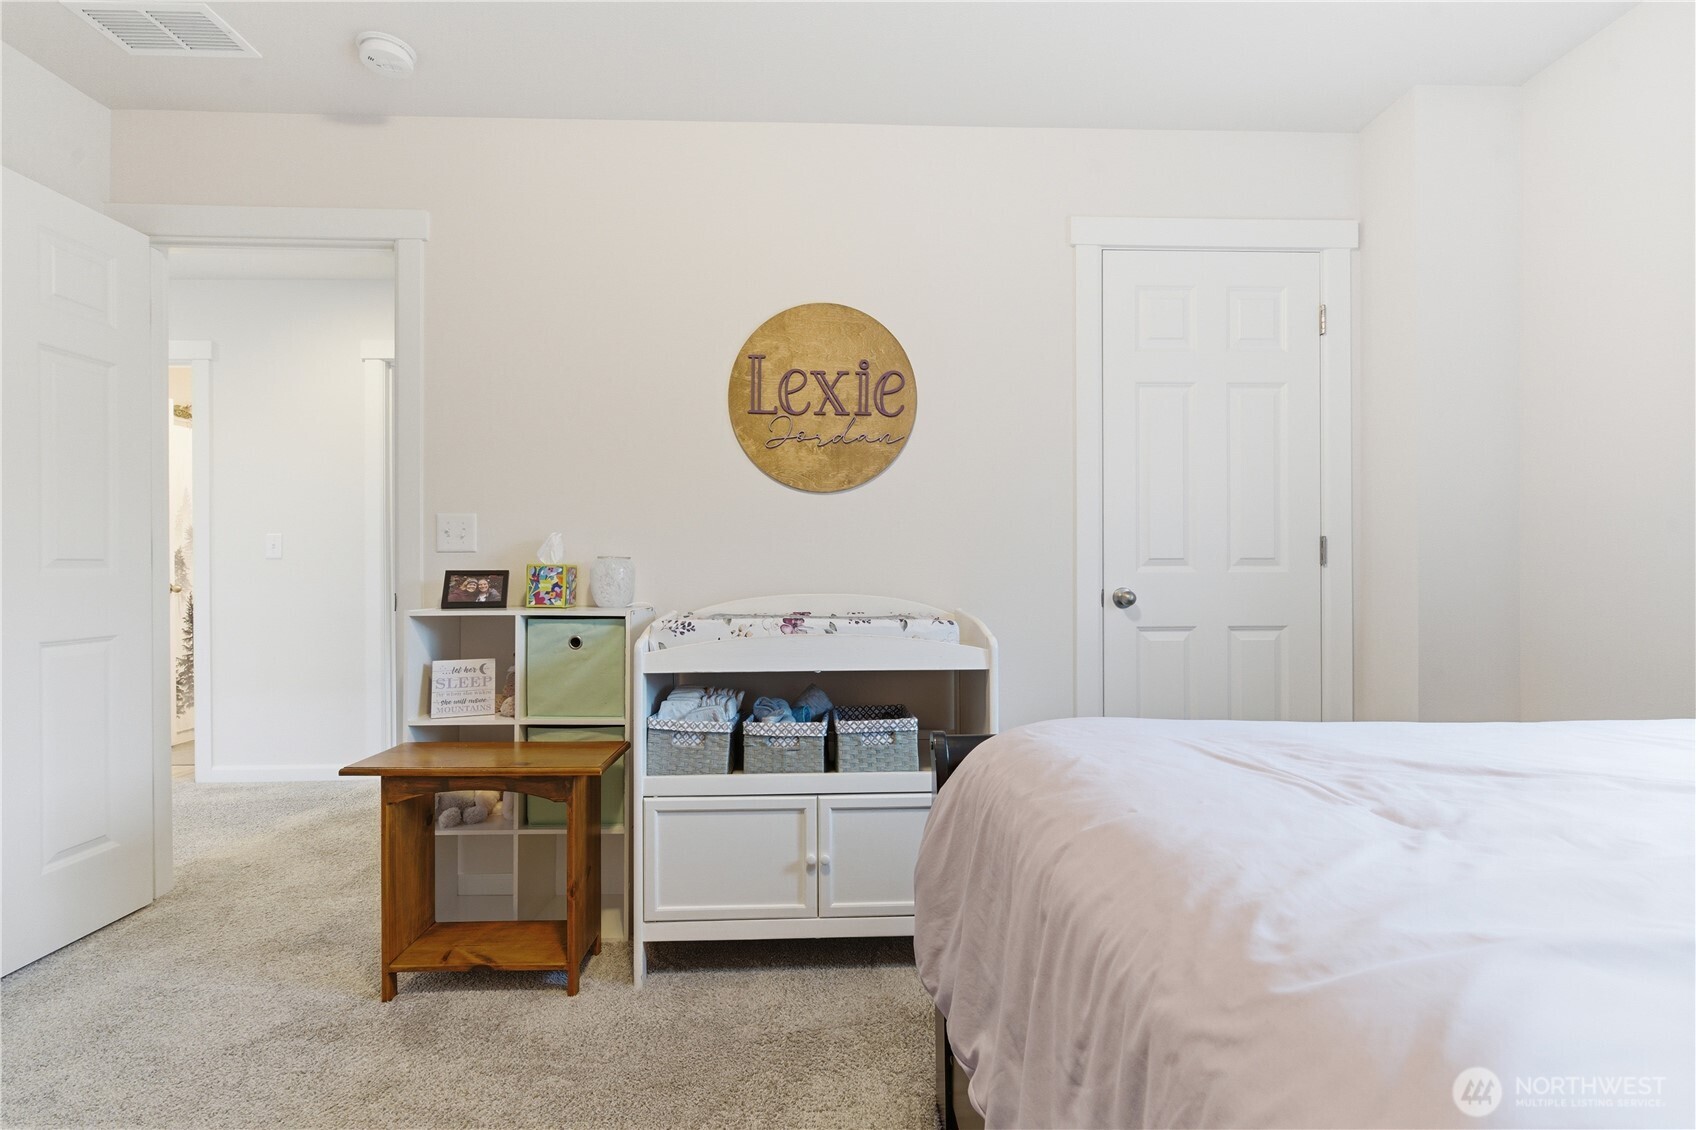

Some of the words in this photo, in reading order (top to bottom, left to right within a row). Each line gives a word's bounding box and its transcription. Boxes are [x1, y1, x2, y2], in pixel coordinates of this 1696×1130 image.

[747, 354, 906, 417] Lexie
[764, 415, 905, 450] Jordan
[463, 666, 478, 674] her
[435, 676, 493, 690] SLEEP
[436, 704, 492, 714] MOUNTAINS
